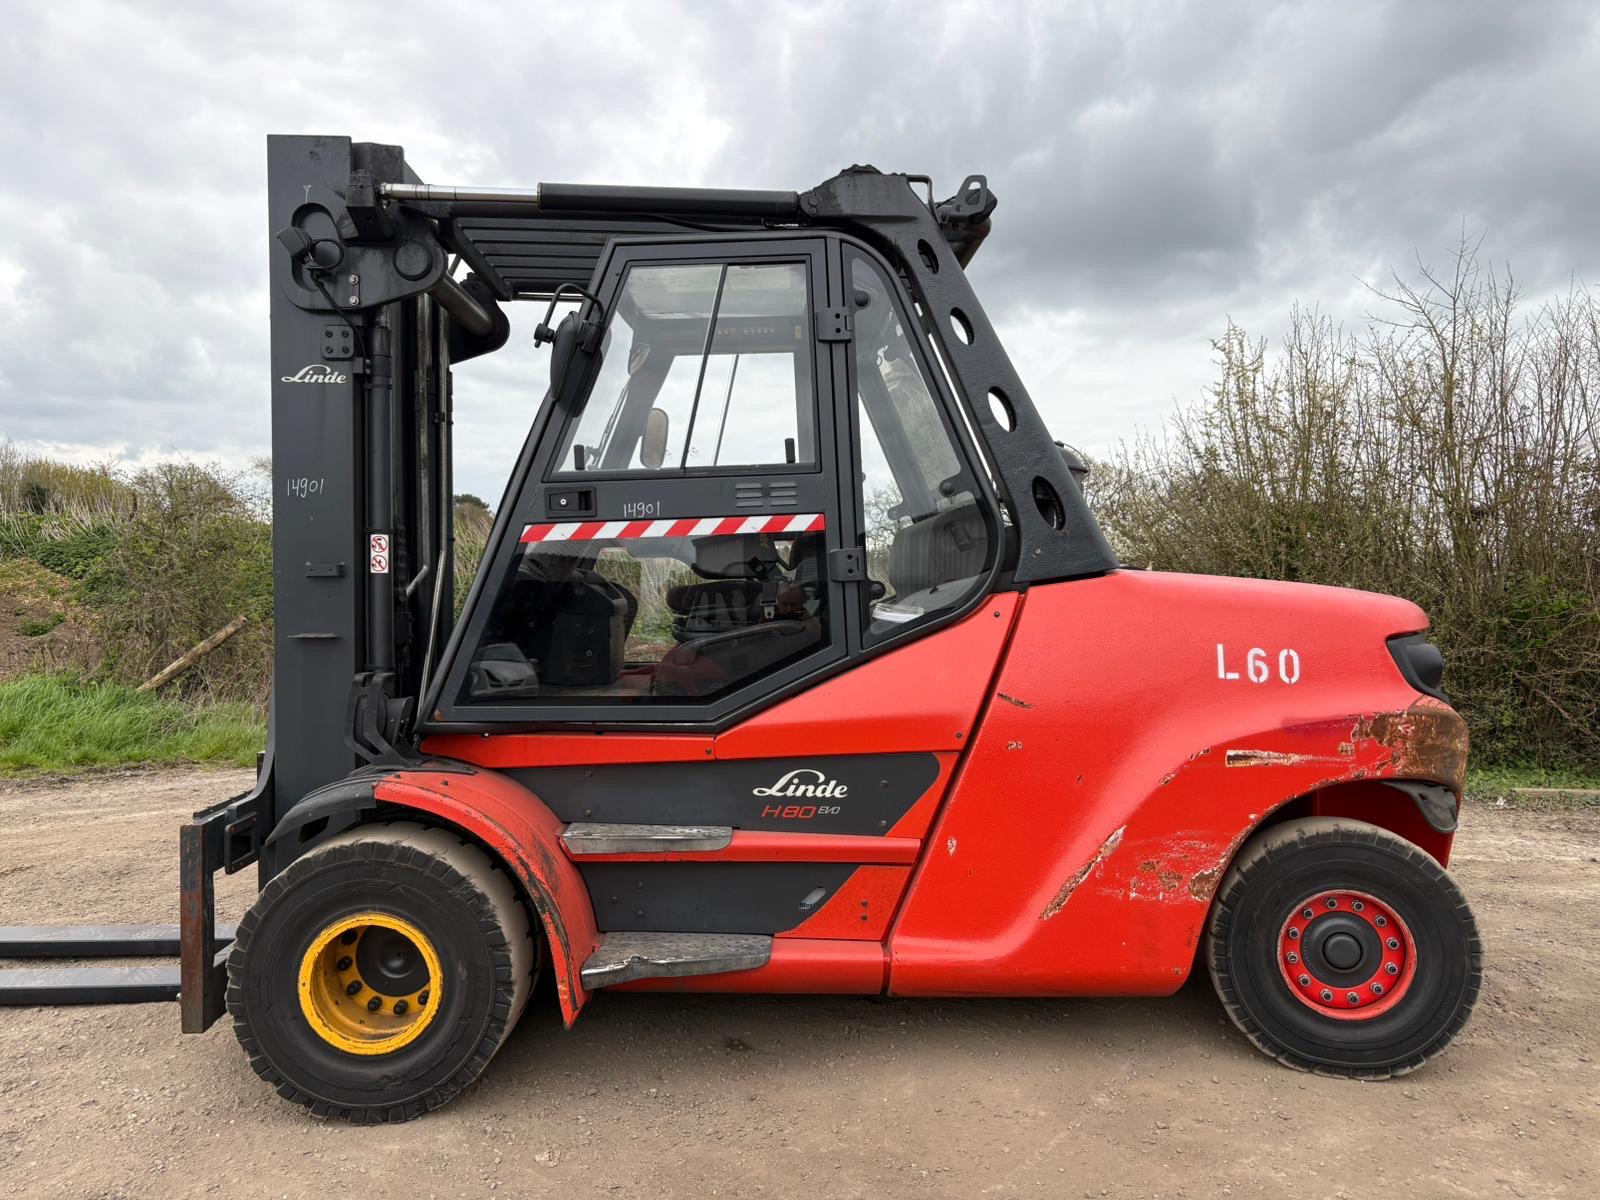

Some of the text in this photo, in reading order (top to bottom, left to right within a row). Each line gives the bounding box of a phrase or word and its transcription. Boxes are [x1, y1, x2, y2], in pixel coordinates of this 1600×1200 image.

[281, 364, 347, 384] Linde
[287, 477, 325, 498] 14901
[623, 500, 661, 518] 14901
[1216, 643, 1301, 684] L60
[752, 769, 848, 798] Linde
